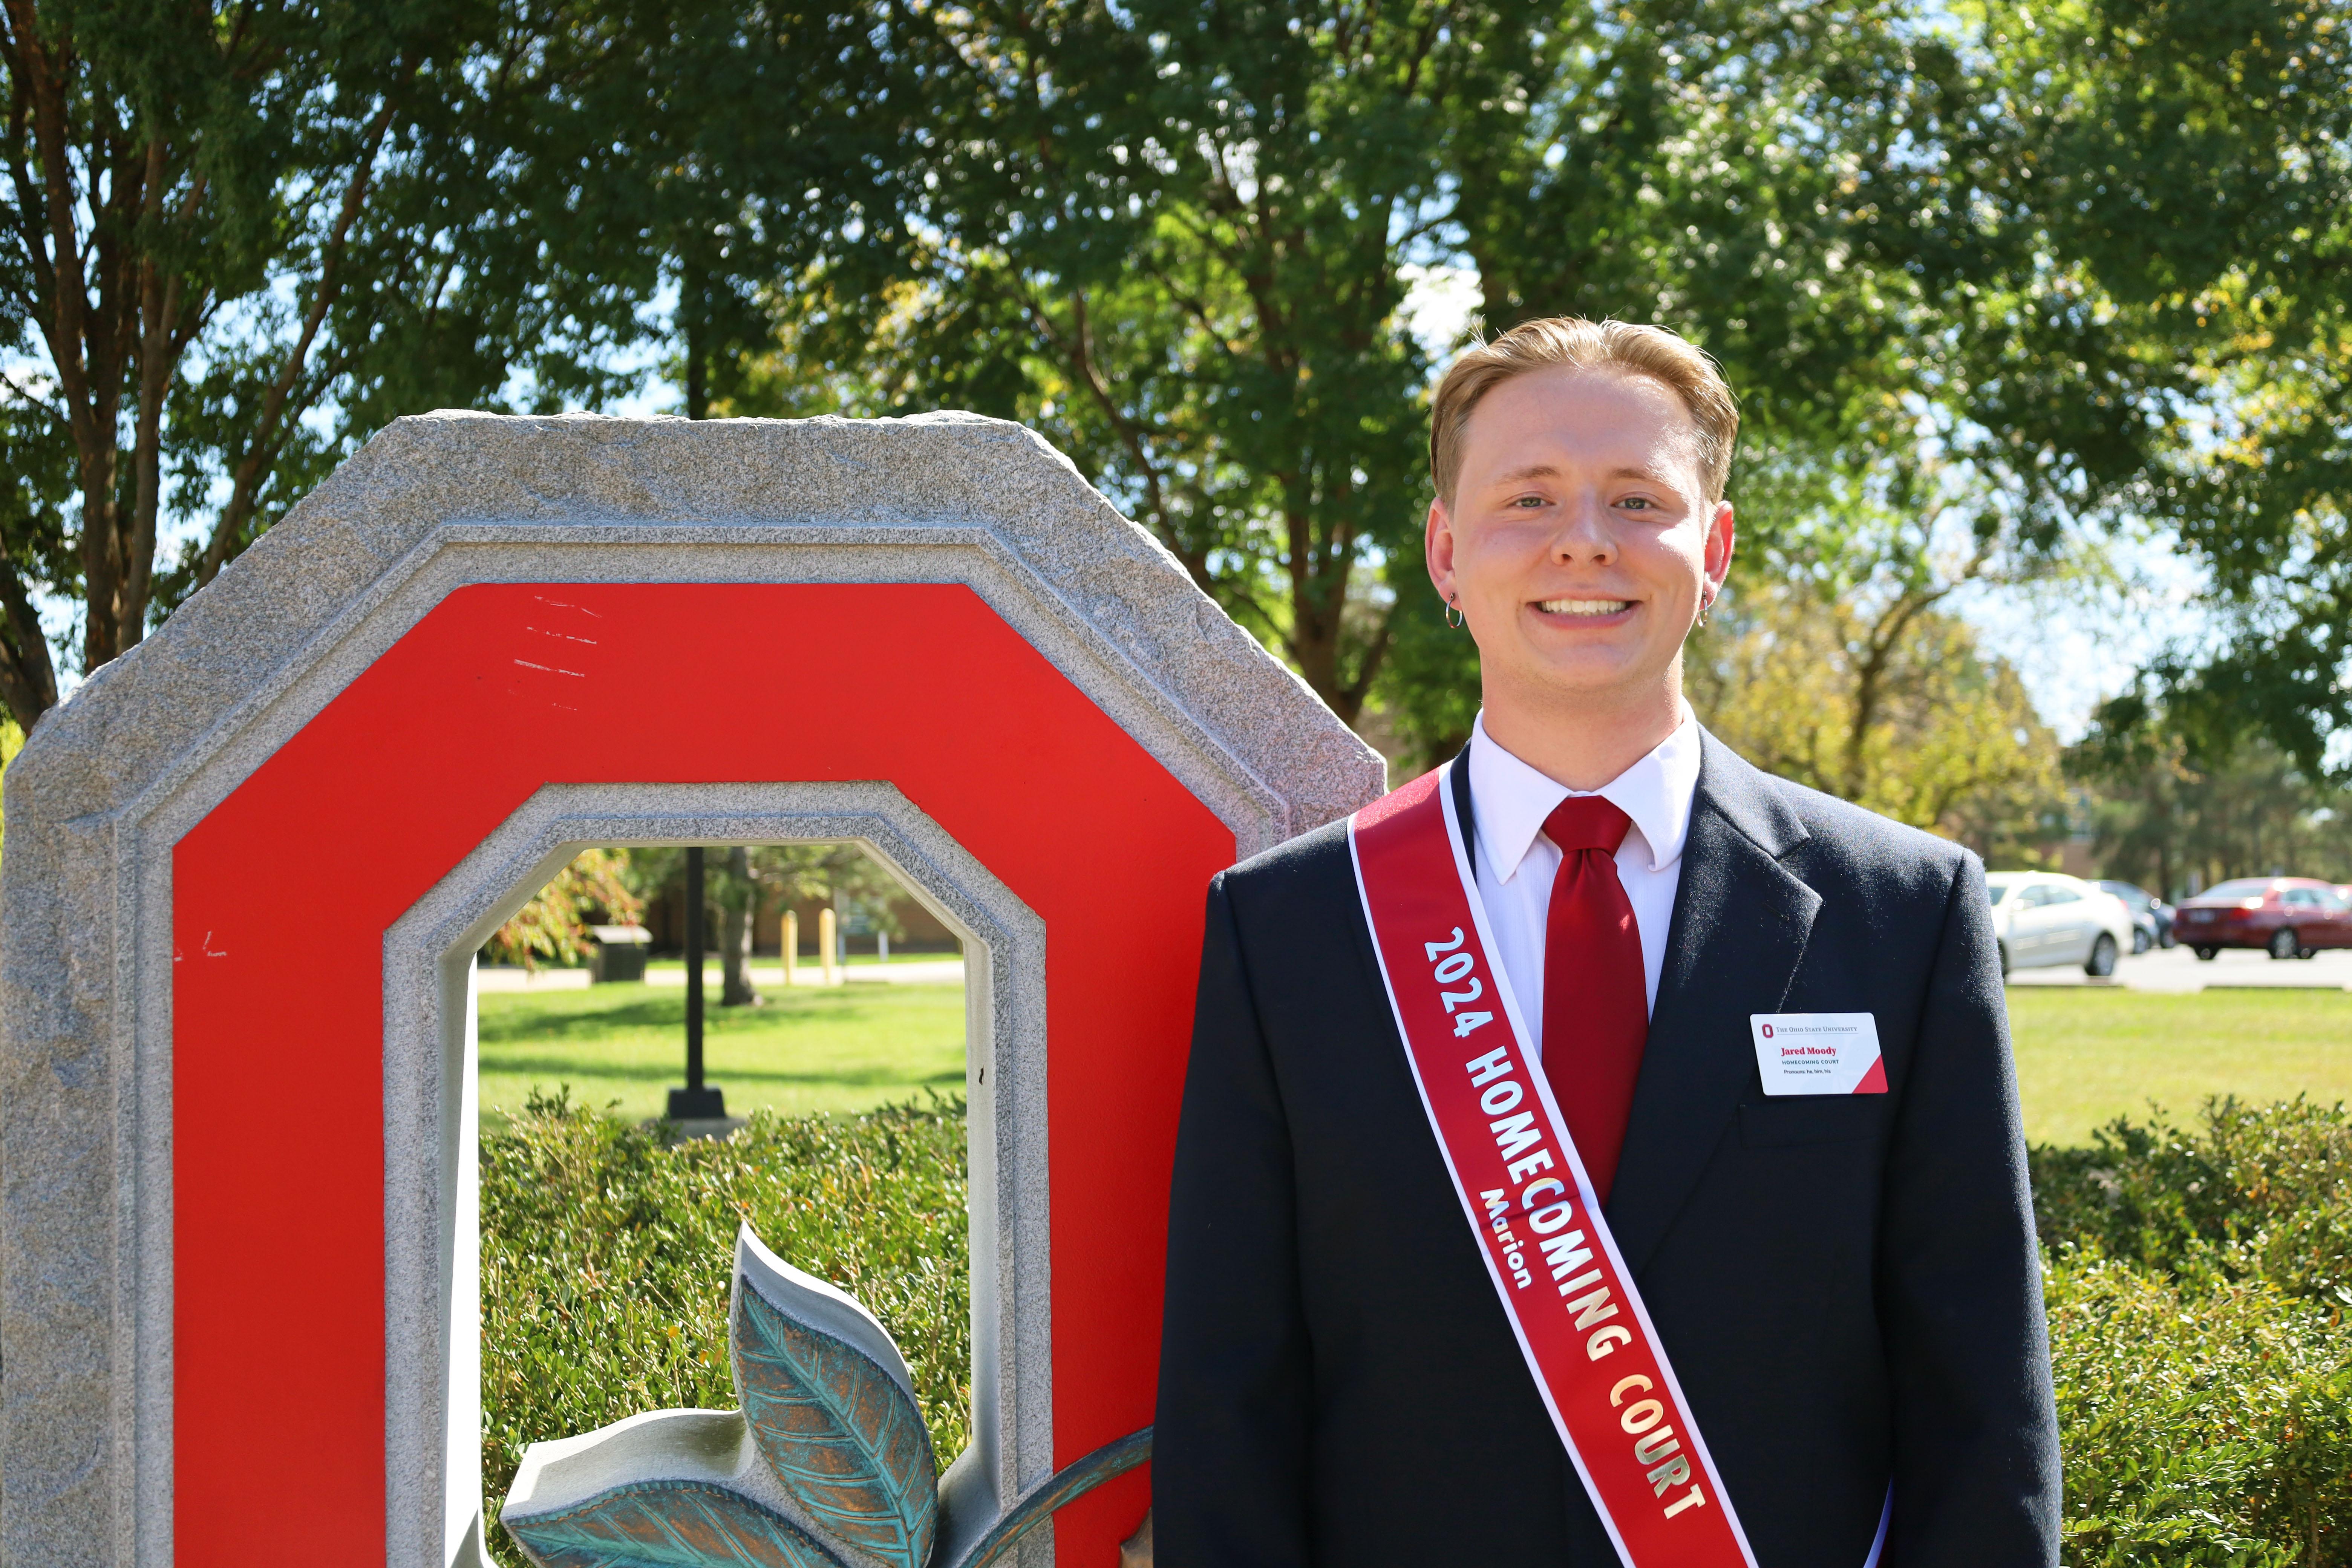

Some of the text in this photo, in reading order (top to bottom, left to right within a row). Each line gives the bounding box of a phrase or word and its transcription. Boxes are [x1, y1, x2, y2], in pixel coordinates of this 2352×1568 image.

[1781, 1046, 1836, 1057] Jared Moody
[1424, 926, 1706, 1519] 2024 HOMECOMING COURT
[1480, 1188, 1531, 1289] Marion
